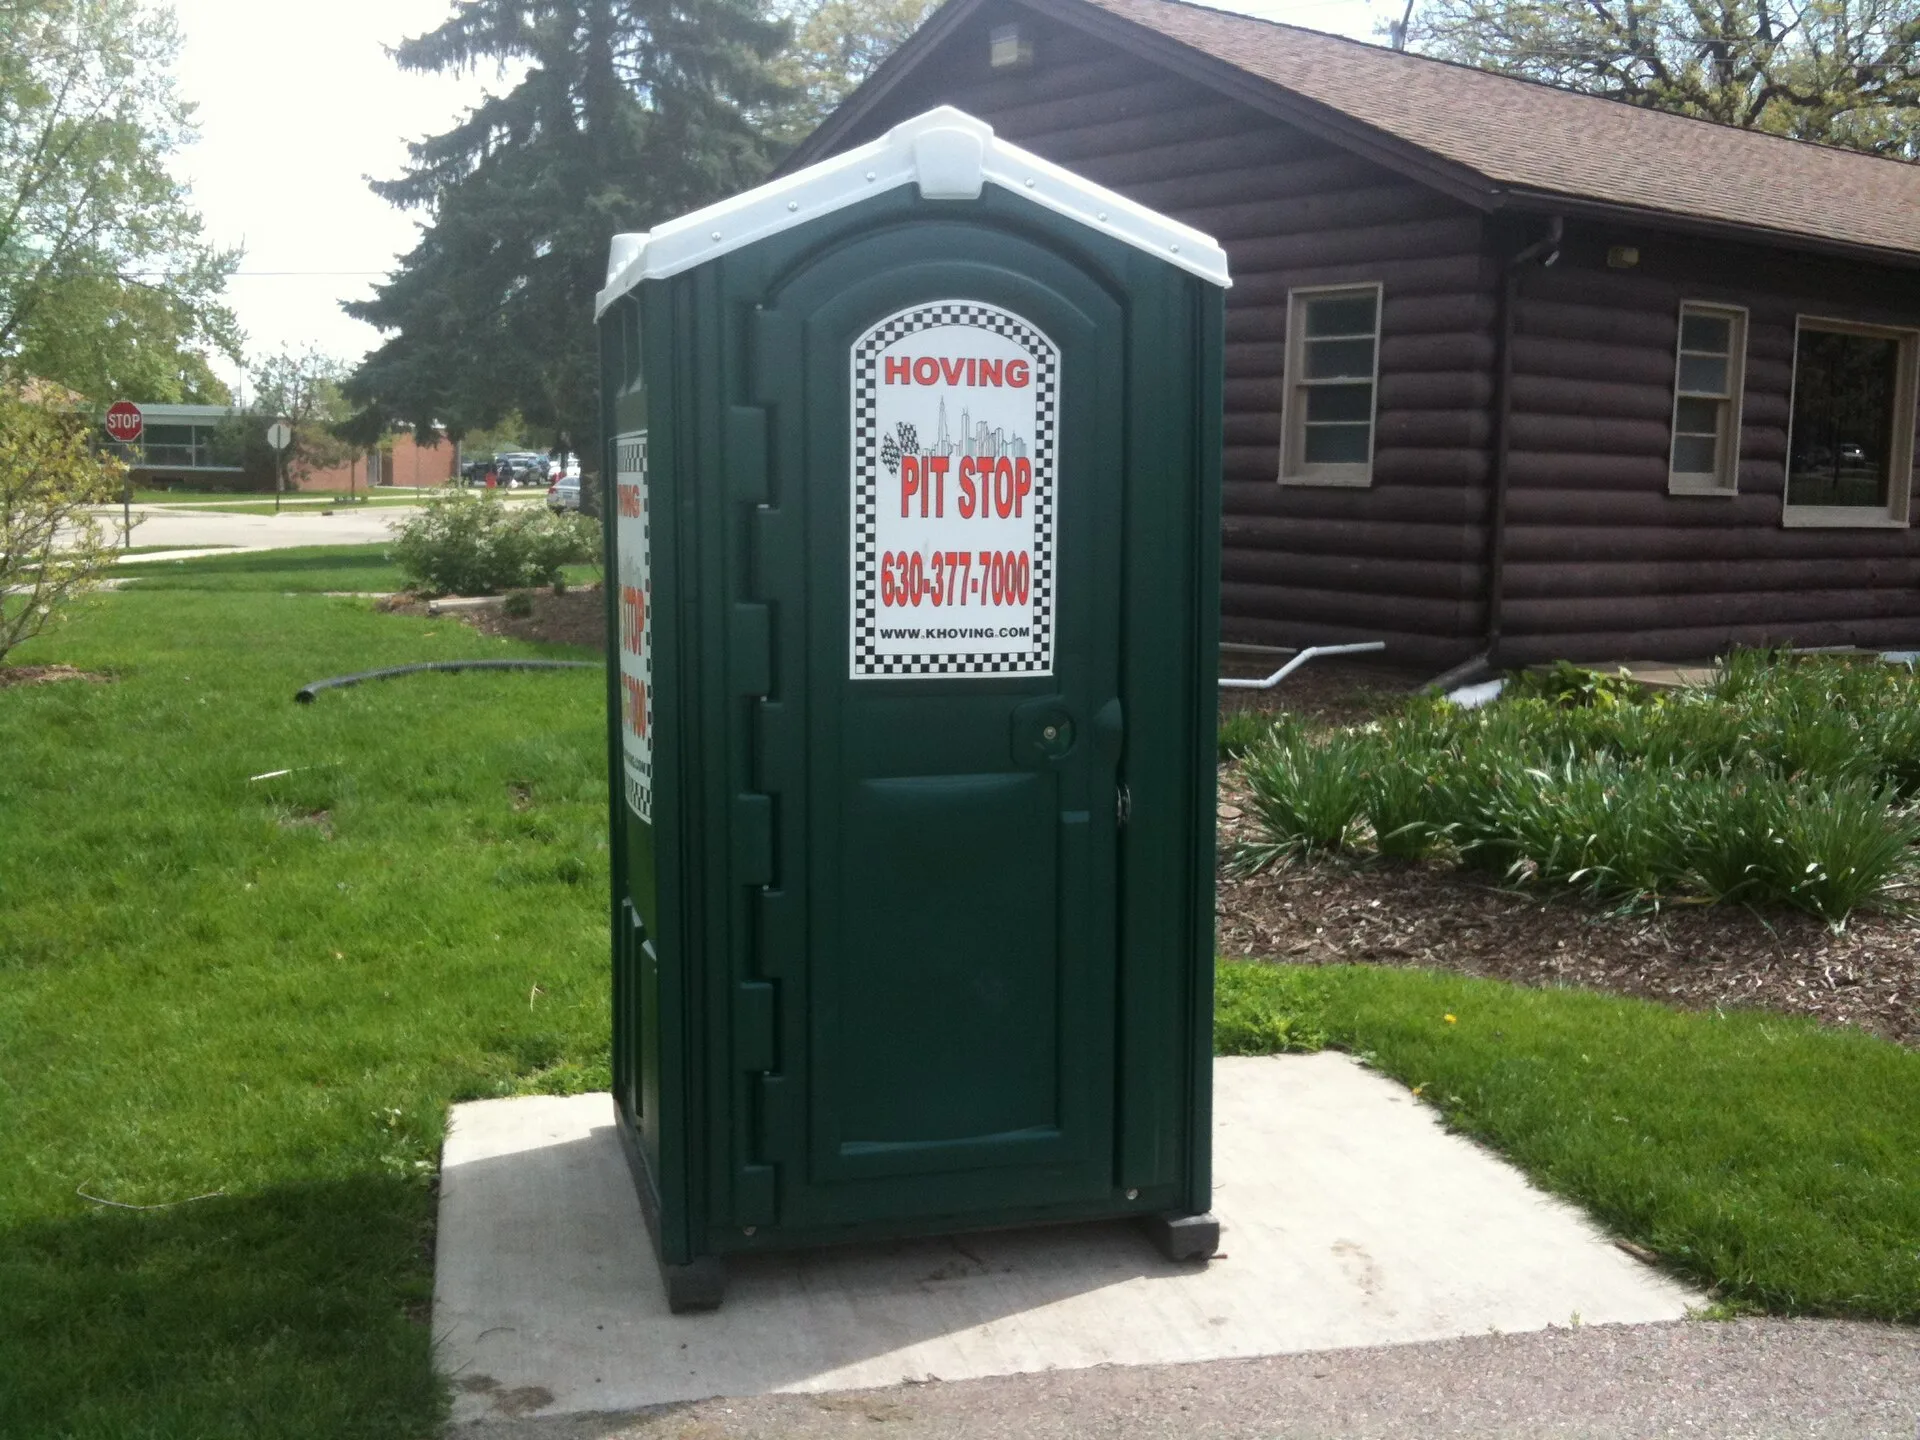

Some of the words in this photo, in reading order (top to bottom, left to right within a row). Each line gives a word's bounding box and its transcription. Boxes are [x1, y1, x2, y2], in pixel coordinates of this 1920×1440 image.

[884, 356, 1030, 388] HOVING
[107, 413, 140, 429] STOP
[901, 455, 949, 518] PIT
[958, 455, 1032, 519] STOP
[881, 550, 1030, 607] 630-377-7000
[880, 627, 1030, 640] WWW.KHOVING.COM
